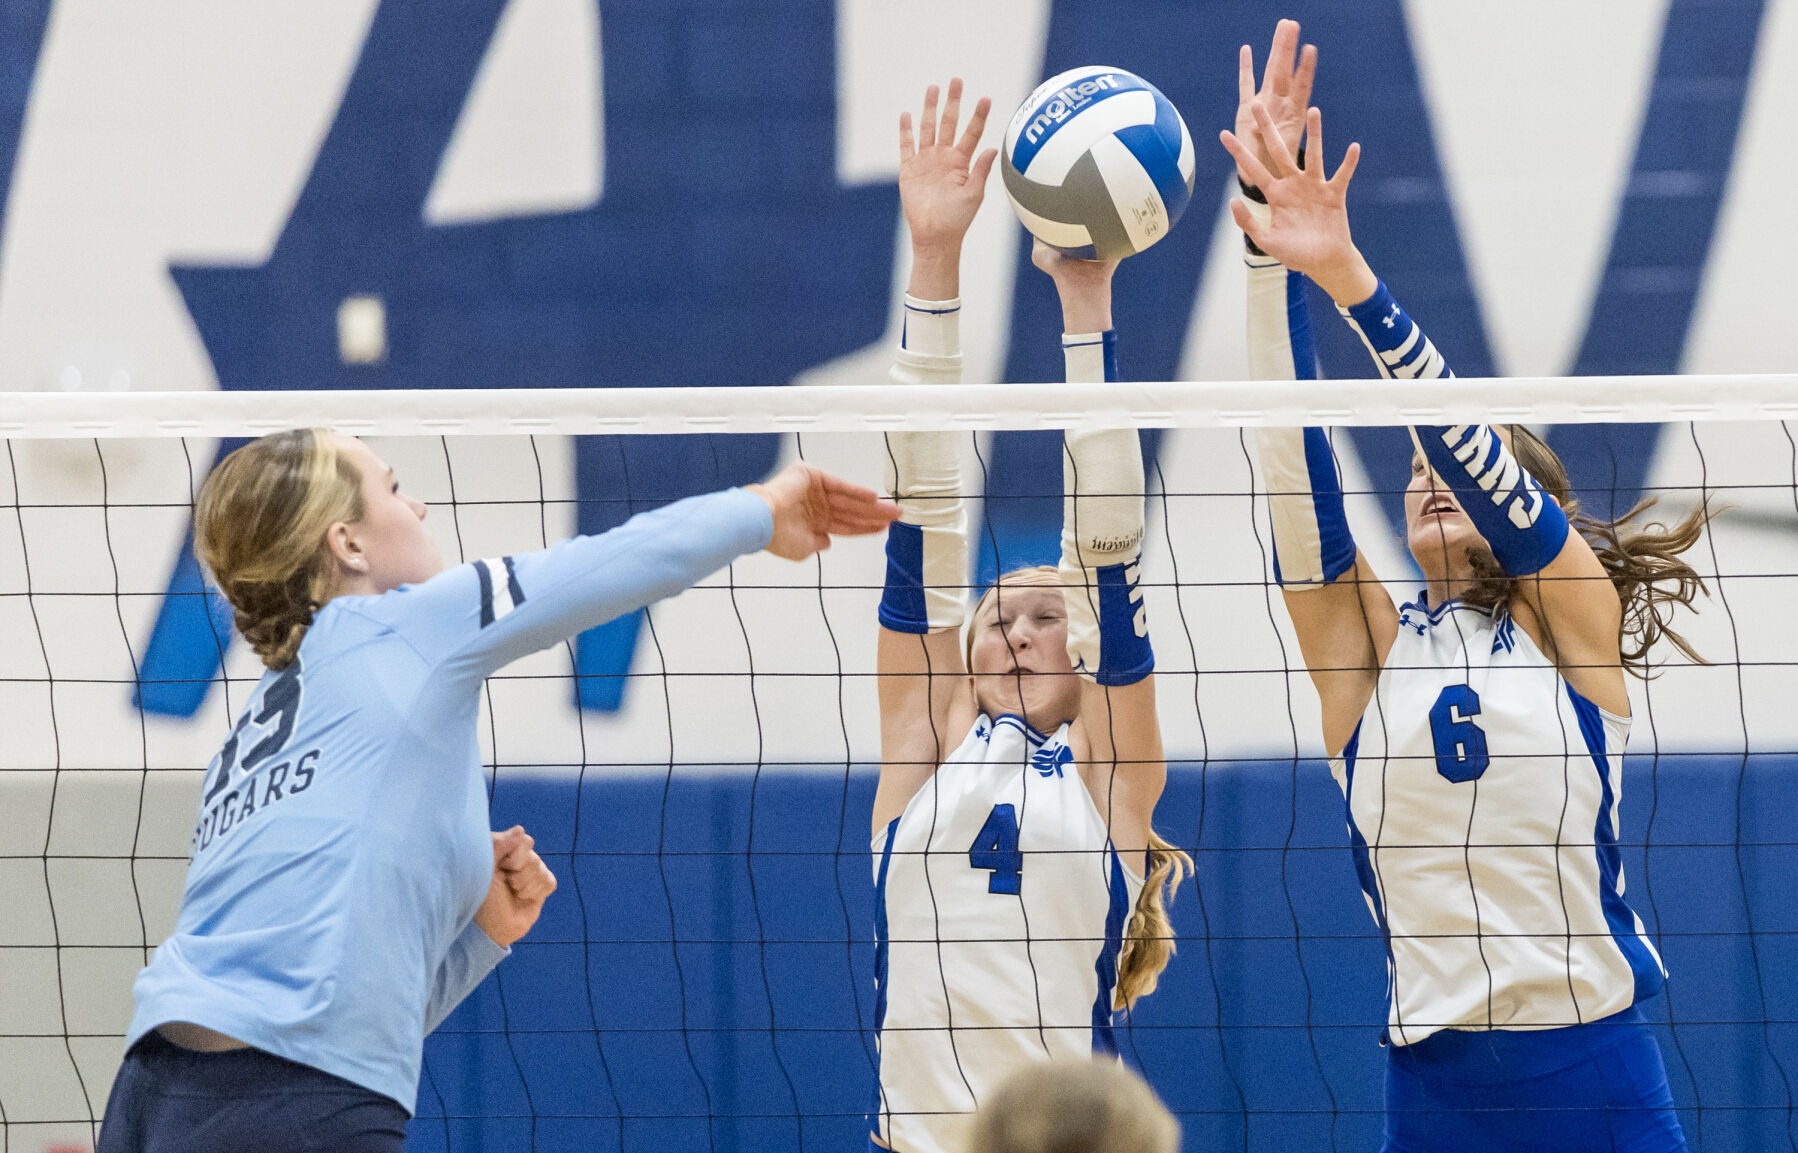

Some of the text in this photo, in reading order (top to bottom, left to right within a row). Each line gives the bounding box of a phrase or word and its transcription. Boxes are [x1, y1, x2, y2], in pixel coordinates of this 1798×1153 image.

[1025, 74, 1119, 145] molten
[1429, 683, 1491, 784] 6
[192, 748, 322, 852] UGARS
[968, 803, 1023, 896] 4
